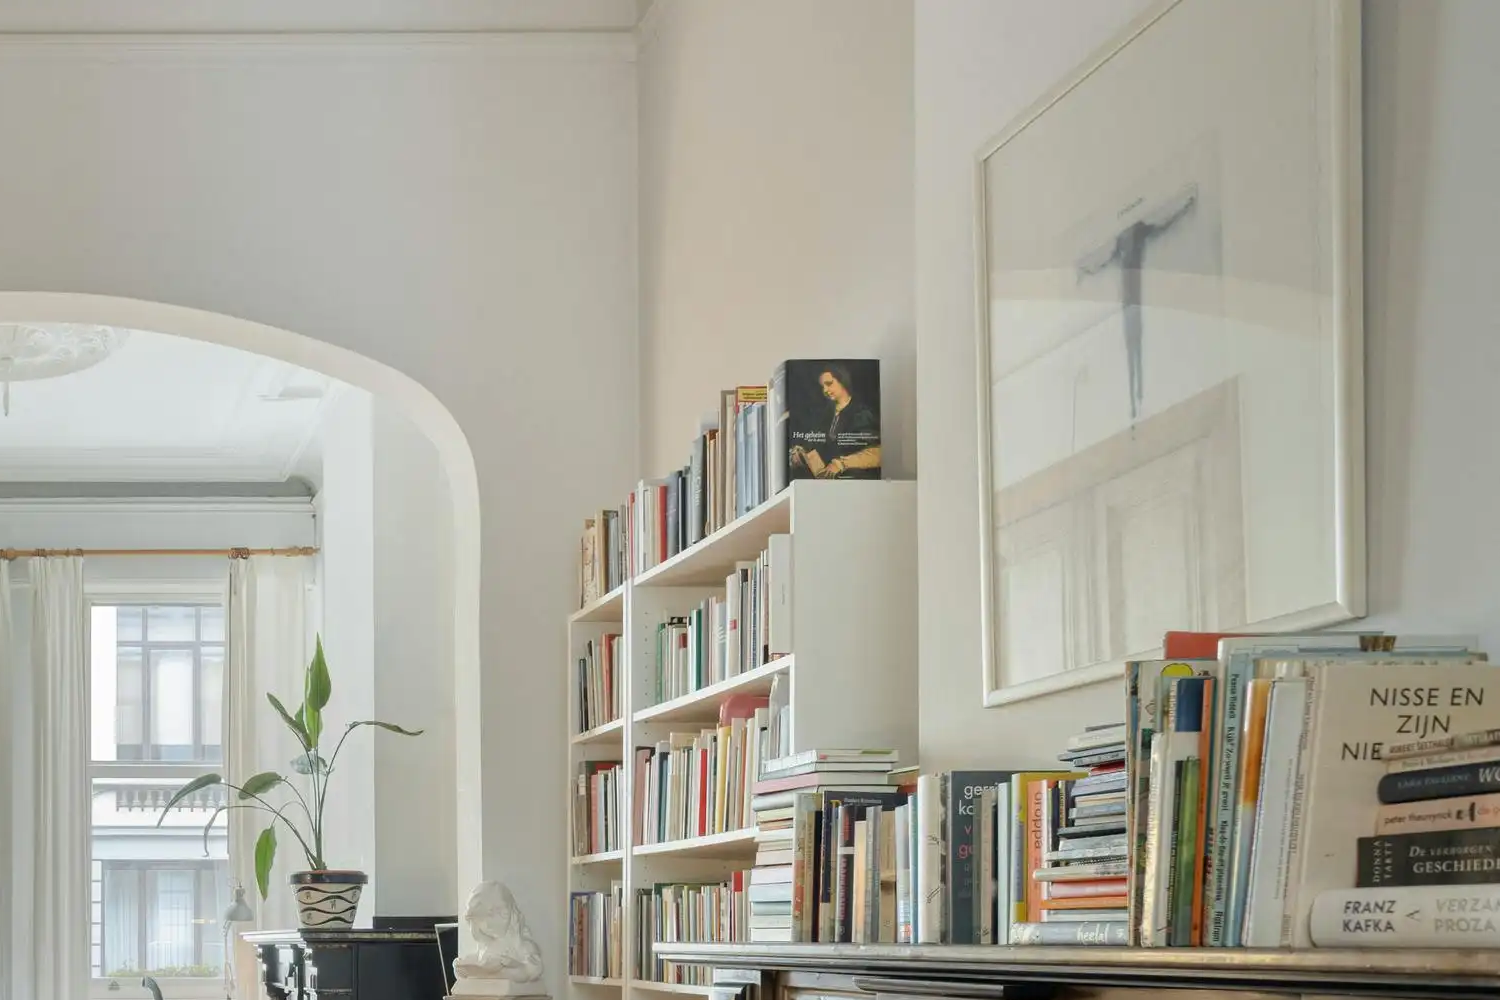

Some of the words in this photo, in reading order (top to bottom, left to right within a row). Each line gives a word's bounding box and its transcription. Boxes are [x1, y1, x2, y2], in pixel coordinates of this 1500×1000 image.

[1369, 687, 1439, 707] NISSE
[1449, 687, 1485, 707] EN
[1396, 715, 1451, 738] ZIJN
[1341, 742, 1385, 761] NIE
[1372, 840, 1382, 883] DONNA
[1384, 841, 1393, 879] TARTT
[1343, 900, 1397, 915] FRANZ
[1342, 918, 1396, 933] KAFKA
[1433, 917, 1497, 933] PROZA
